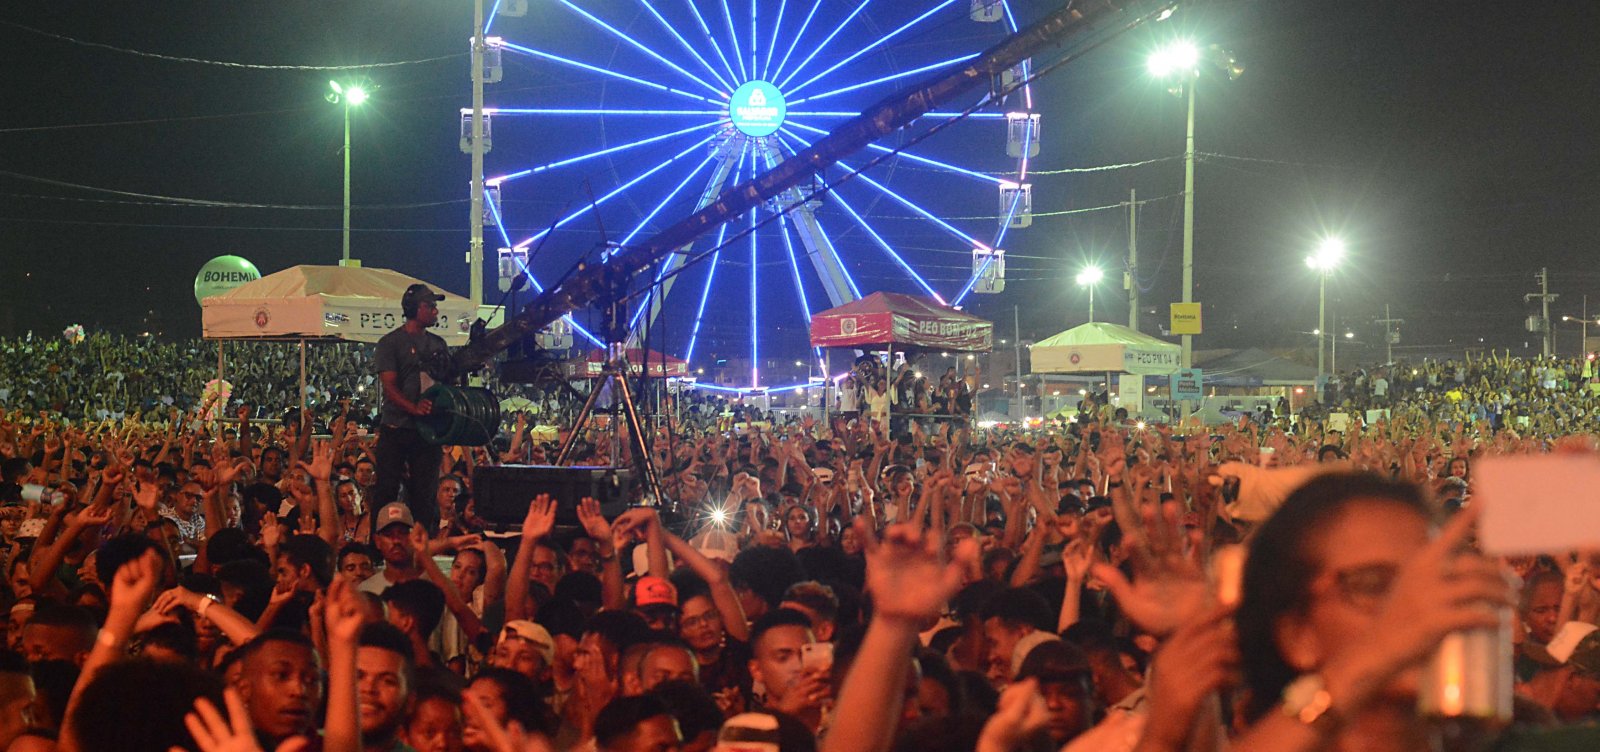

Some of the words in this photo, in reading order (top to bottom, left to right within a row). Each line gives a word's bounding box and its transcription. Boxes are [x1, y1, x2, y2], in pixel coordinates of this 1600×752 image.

[203, 271, 257, 282] BOHEMIA
[360, 312, 396, 329] PEO
[919, 320, 938, 335] PEO
